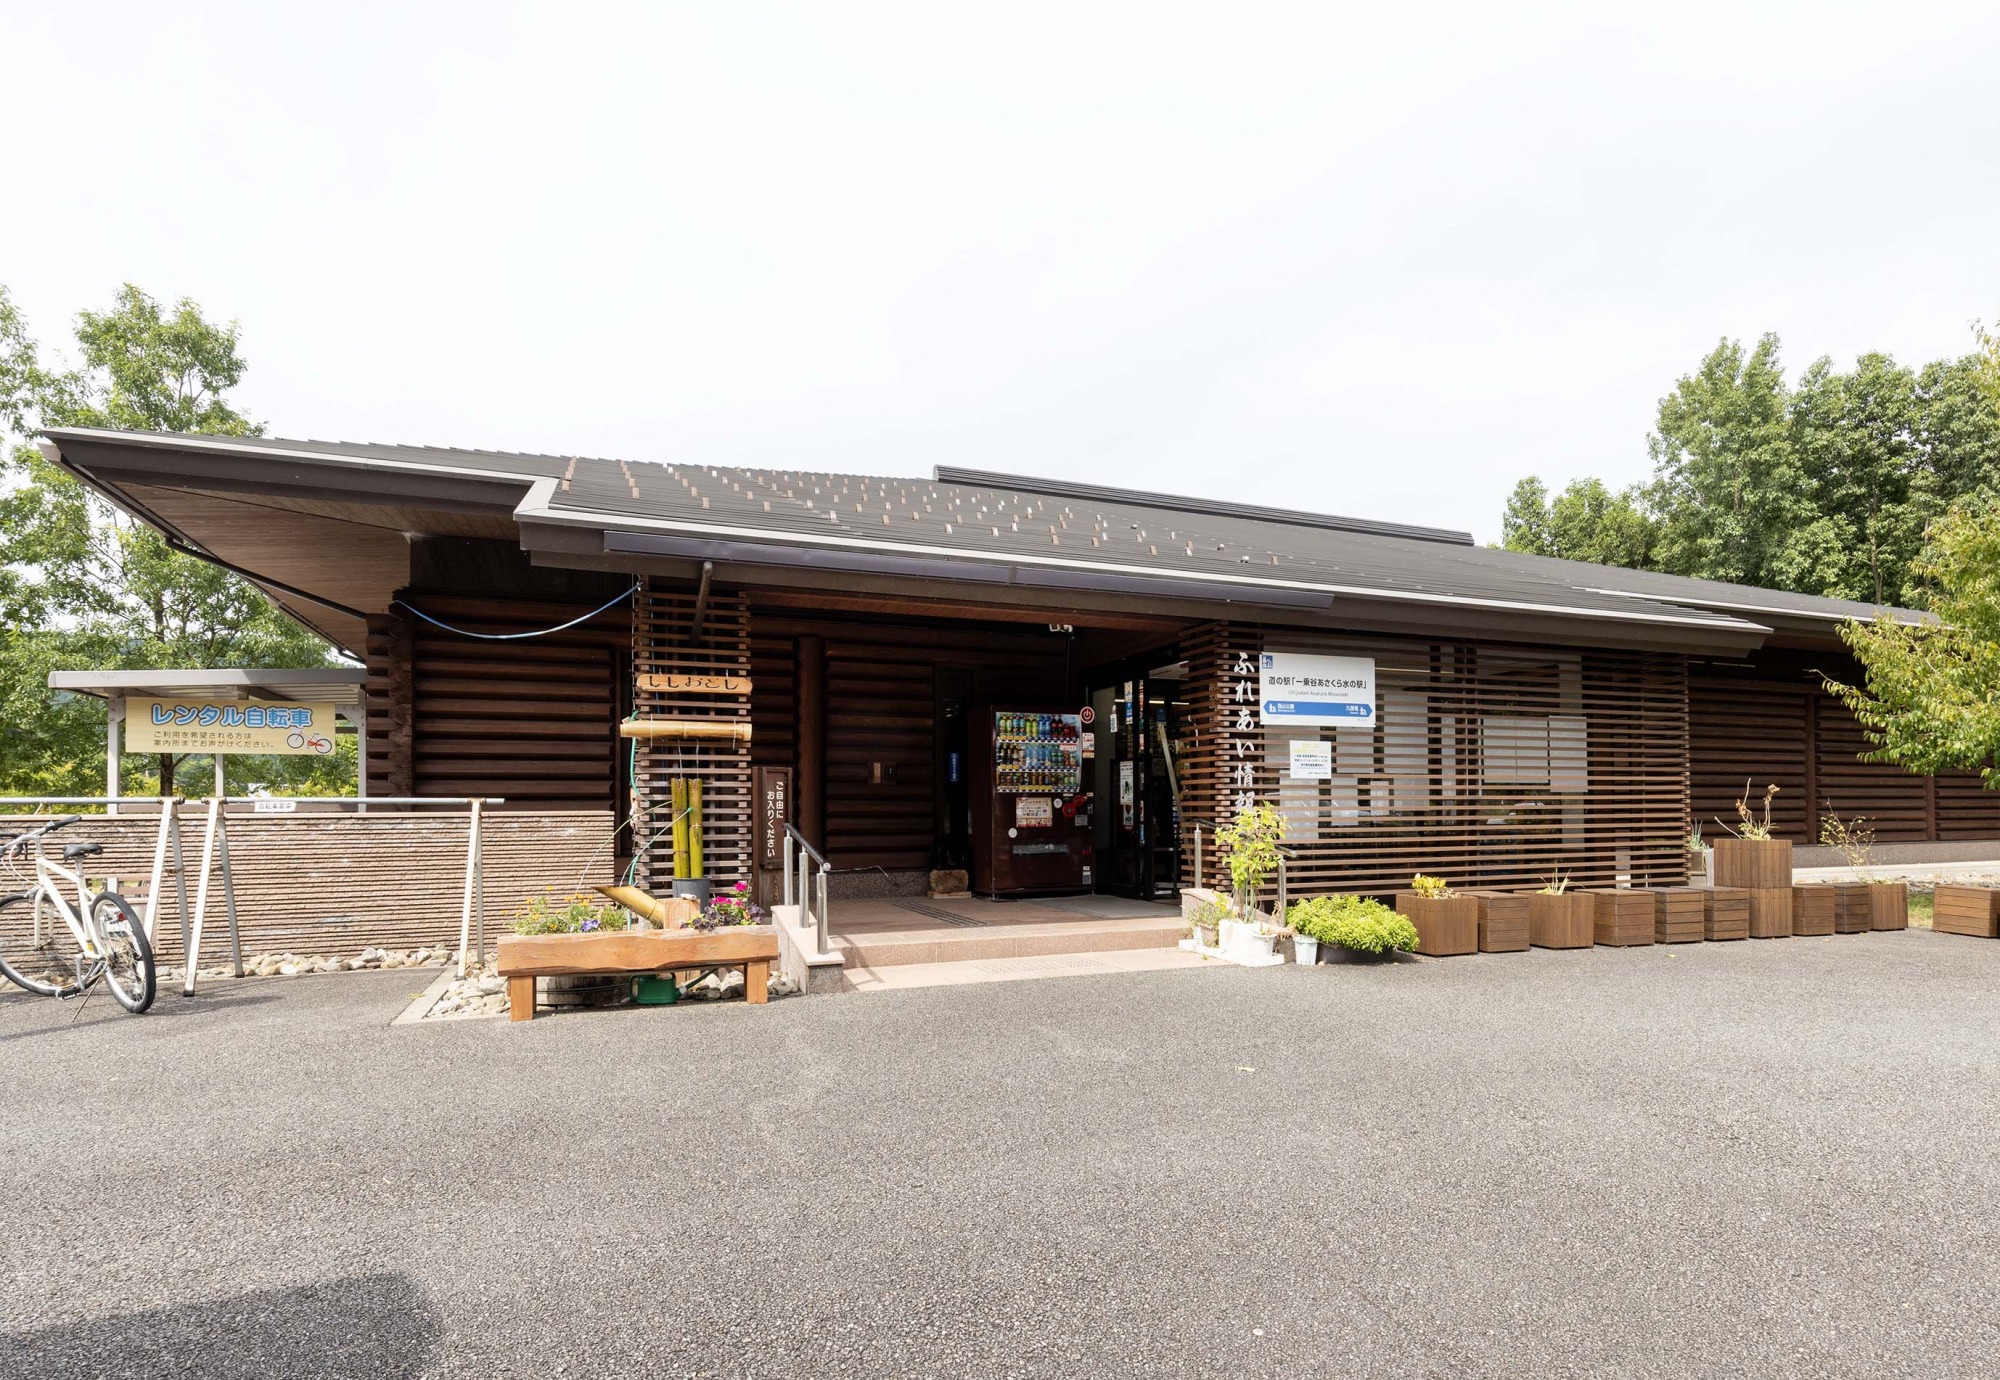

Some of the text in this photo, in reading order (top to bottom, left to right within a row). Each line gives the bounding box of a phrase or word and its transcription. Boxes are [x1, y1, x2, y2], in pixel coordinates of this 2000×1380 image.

[649, 675, 739, 690] ししおどし
[152, 704, 313, 728] レンタル自転車
[153, 731, 252, 740] ご利用を希望される方は
[153, 739, 274, 749] 案内所までお声がけください。
[776, 781, 784, 819] ご自由に
[767, 791, 776, 857] お入りください
